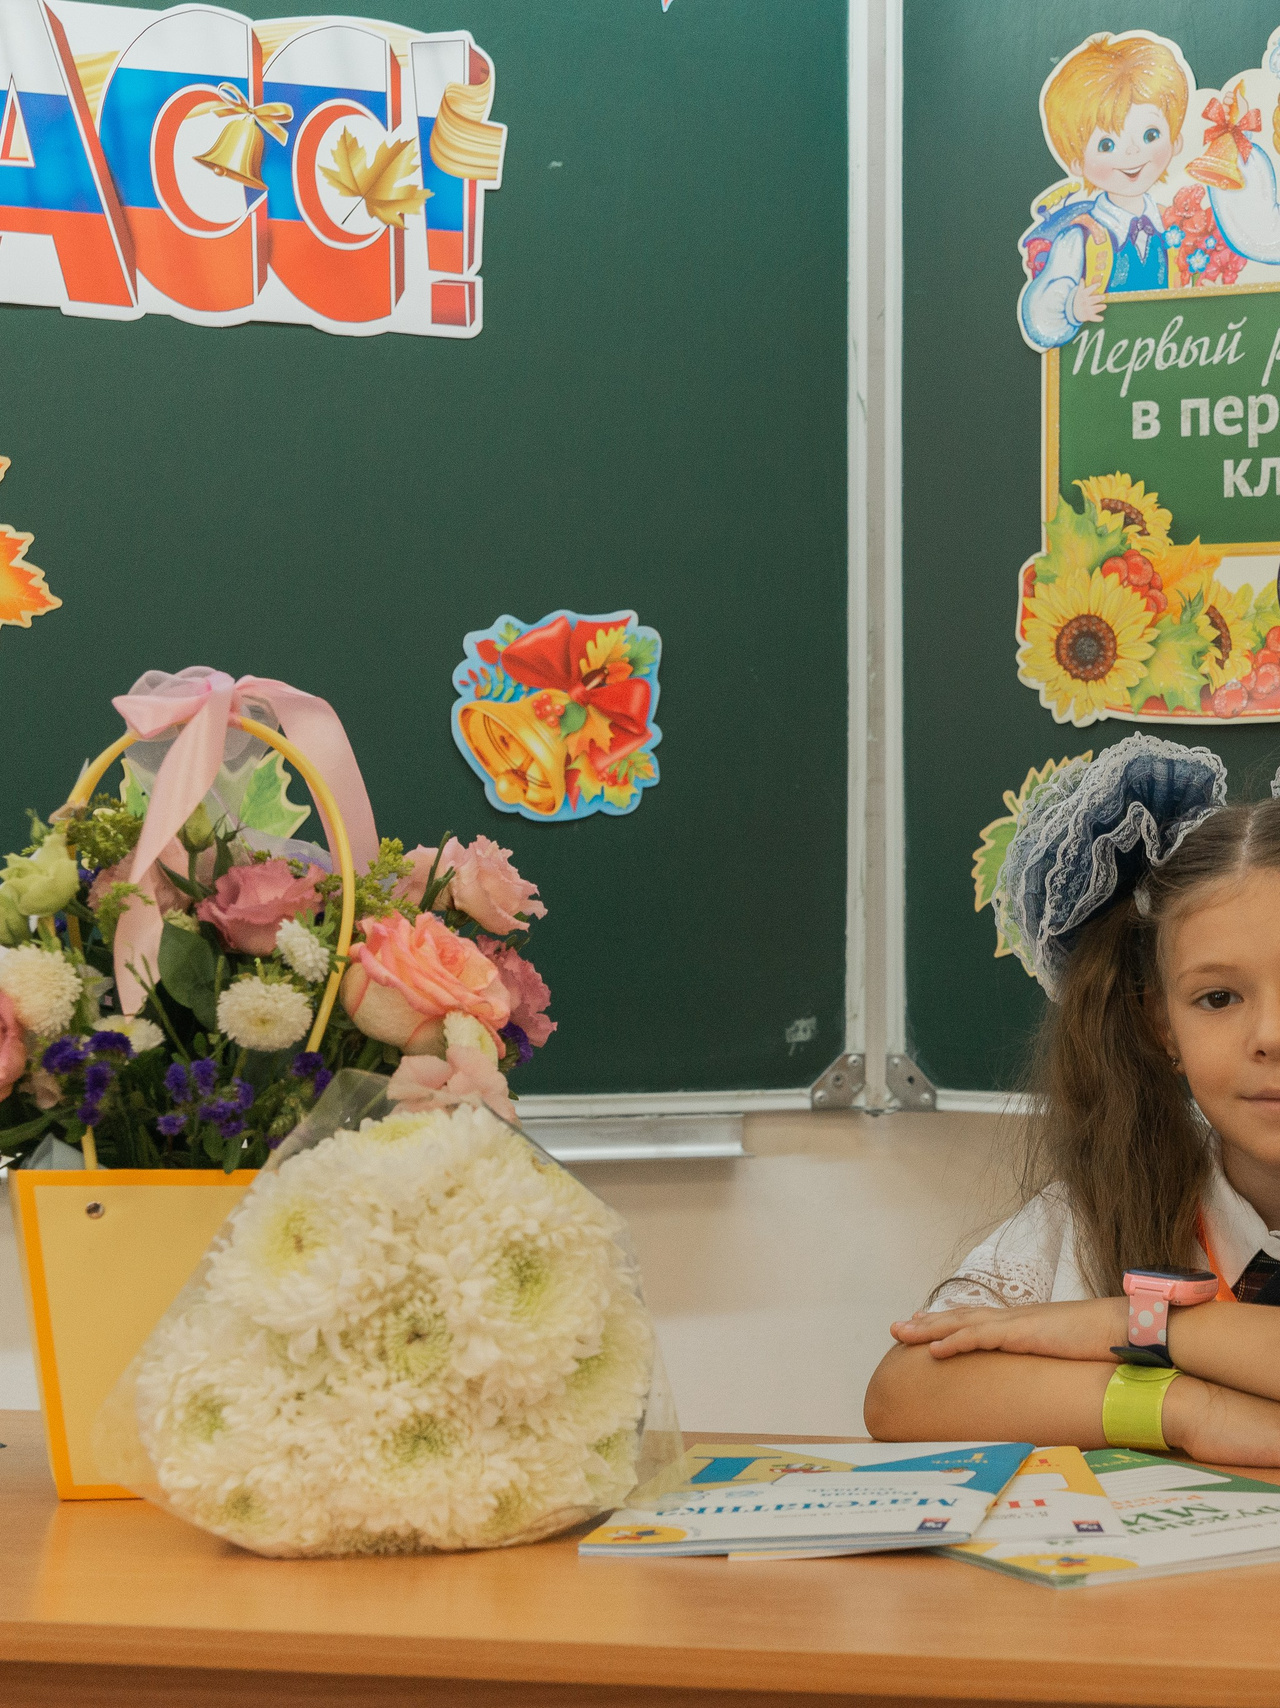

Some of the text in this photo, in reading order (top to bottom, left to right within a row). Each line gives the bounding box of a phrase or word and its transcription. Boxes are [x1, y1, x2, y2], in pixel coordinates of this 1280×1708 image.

[1072, 315, 1247, 398] Первый
[1131, 400, 1161, 440] в
[655, 1498, 958, 1517] Математика
